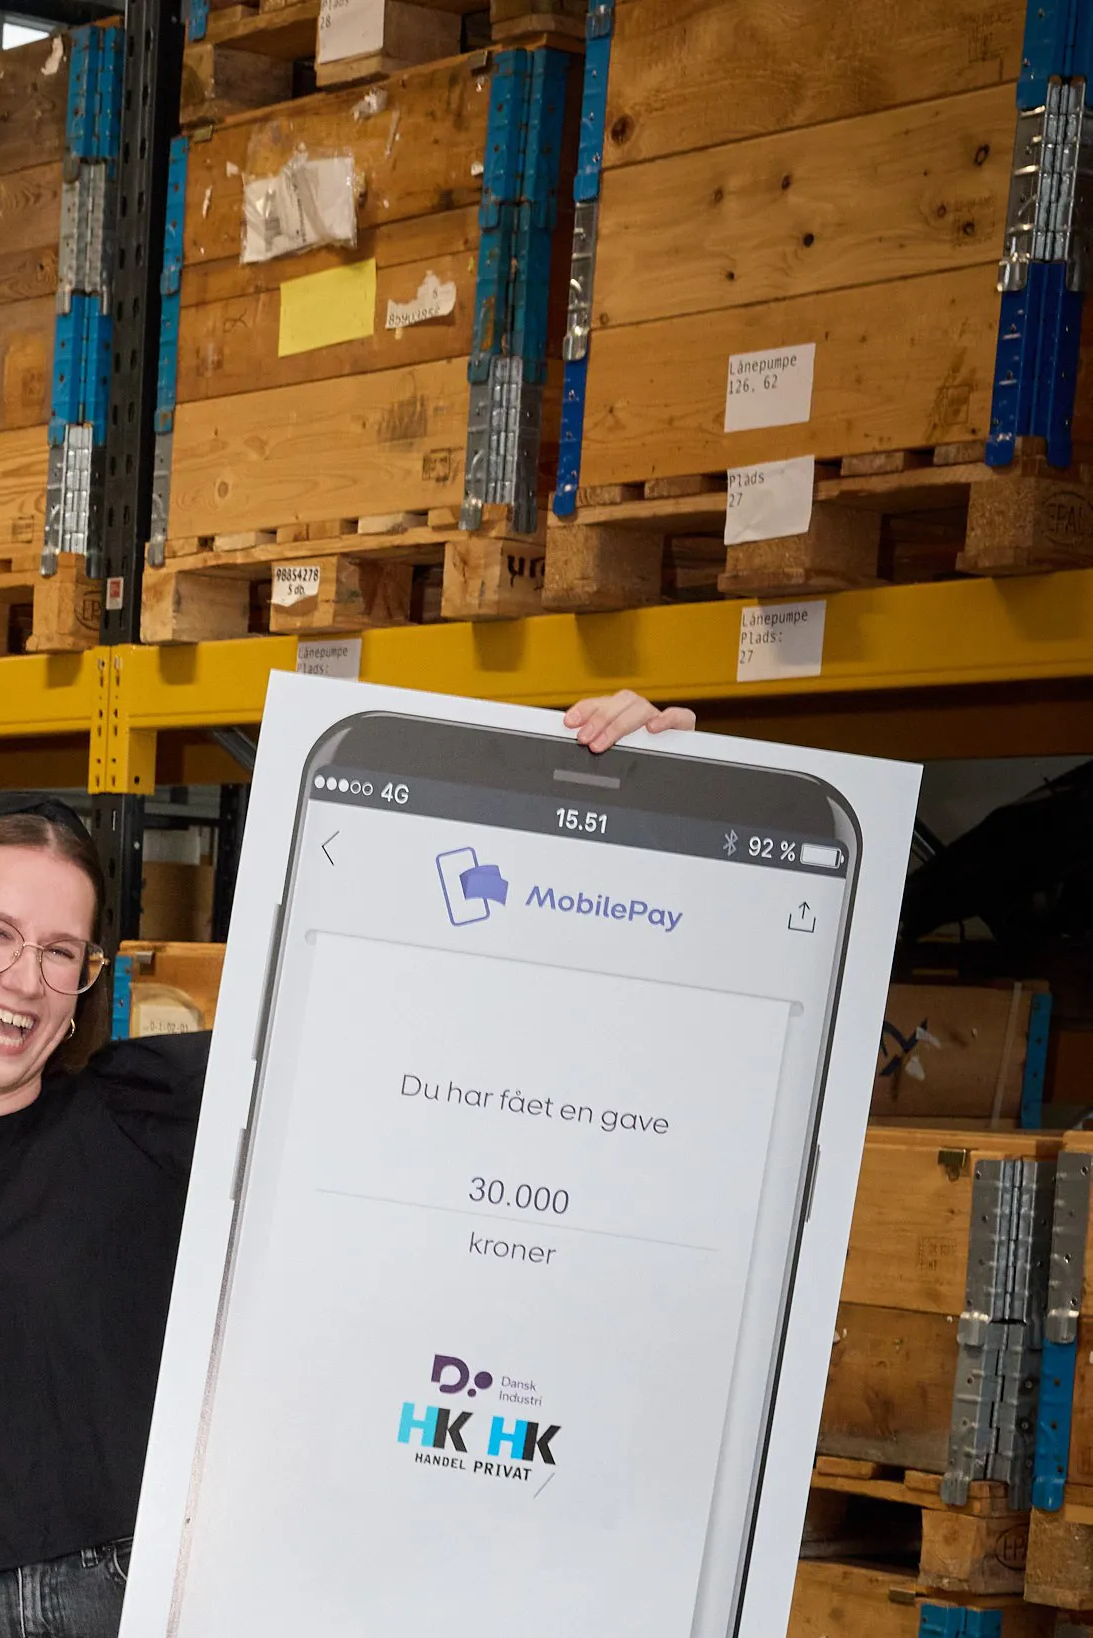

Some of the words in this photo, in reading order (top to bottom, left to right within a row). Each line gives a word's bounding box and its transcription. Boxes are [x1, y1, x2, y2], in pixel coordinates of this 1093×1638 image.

[320, 13, 331, 30] 28
[729, 355, 797, 376] Lånepumpe
[763, 374, 778, 390] 62
[729, 470, 765, 488] Plads
[729, 492, 743, 508] 27
[741, 609, 809, 628] Lånepumpe
[740, 629, 783, 645] Plads:
[298, 647, 349, 660] Lånepumpe
[739, 649, 754, 664] 27
[380, 782, 410, 805] 4G
[555, 808, 608, 835] 15.51
[748, 836, 775, 859] 92
[779, 841, 797, 862] %
[524, 884, 684, 934] MobilePay
[400, 1073, 441, 1102] Du
[447, 1081, 494, 1109] har
[499, 1088, 554, 1119] fået
[560, 1101, 594, 1124] en
[600, 1109, 671, 1135] gave
[468, 1176, 571, 1216] 30.000
[468, 1231, 558, 1265] kroner
[501, 1375, 537, 1392] Dansk
[499, 1390, 544, 1407] Industri
[397, 1402, 474, 1454] HK
[487, 1415, 563, 1466] HK
[415, 1452, 467, 1470] HANDEL
[473, 1460, 533, 1482] PRIVAT
